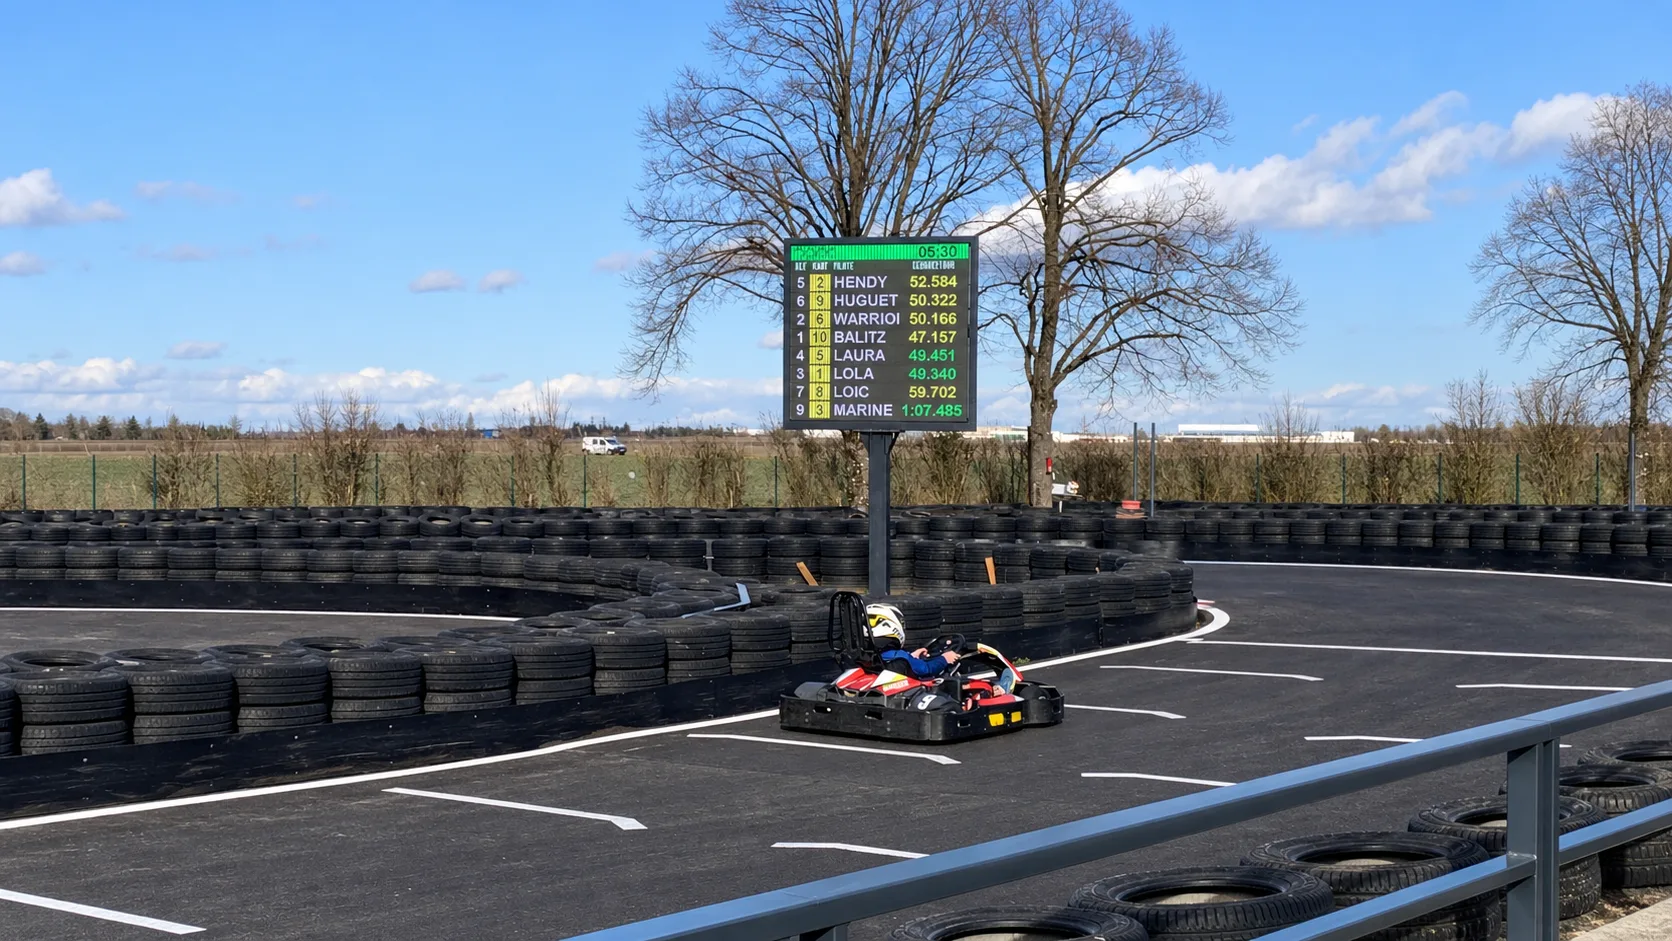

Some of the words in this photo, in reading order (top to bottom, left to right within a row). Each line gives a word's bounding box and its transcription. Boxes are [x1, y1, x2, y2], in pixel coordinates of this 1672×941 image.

[918, 245, 957, 258] 05:30
[797, 276, 805, 288] 5
[816, 277, 824, 289] 2
[834, 276, 887, 288] HENDY
[910, 275, 957, 288] 52.584
[797, 294, 805, 306] 6
[816, 294, 824, 306] 9
[834, 294, 898, 306] HUGUET
[909, 293, 957, 306] 50.322
[797, 313, 805, 325] 2
[816, 313, 824, 324] 6
[909, 312, 957, 325] 50.166
[797, 331, 803, 343] 1
[812, 331, 827, 343] 10
[834, 331, 886, 343] BALITZ
[908, 330, 957, 343] 47.157
[796, 349, 805, 361] 4
[816, 349, 824, 361] 5
[834, 349, 885, 361] LAURA
[909, 348, 955, 361] 49.451
[796, 368, 805, 380] 3
[817, 368, 822, 379] 1
[834, 368, 874, 380] LOLA
[909, 367, 956, 380] 49.340
[796, 386, 805, 398] 7
[816, 386, 824, 397] 8
[834, 386, 869, 398] LOIC
[909, 385, 956, 398] 59.702
[796, 404, 805, 416] 9
[816, 404, 824, 415] 3
[834, 404, 892, 416] MARINE
[902, 403, 962, 416] 1:07.485
[917, 694, 938, 711] 9
